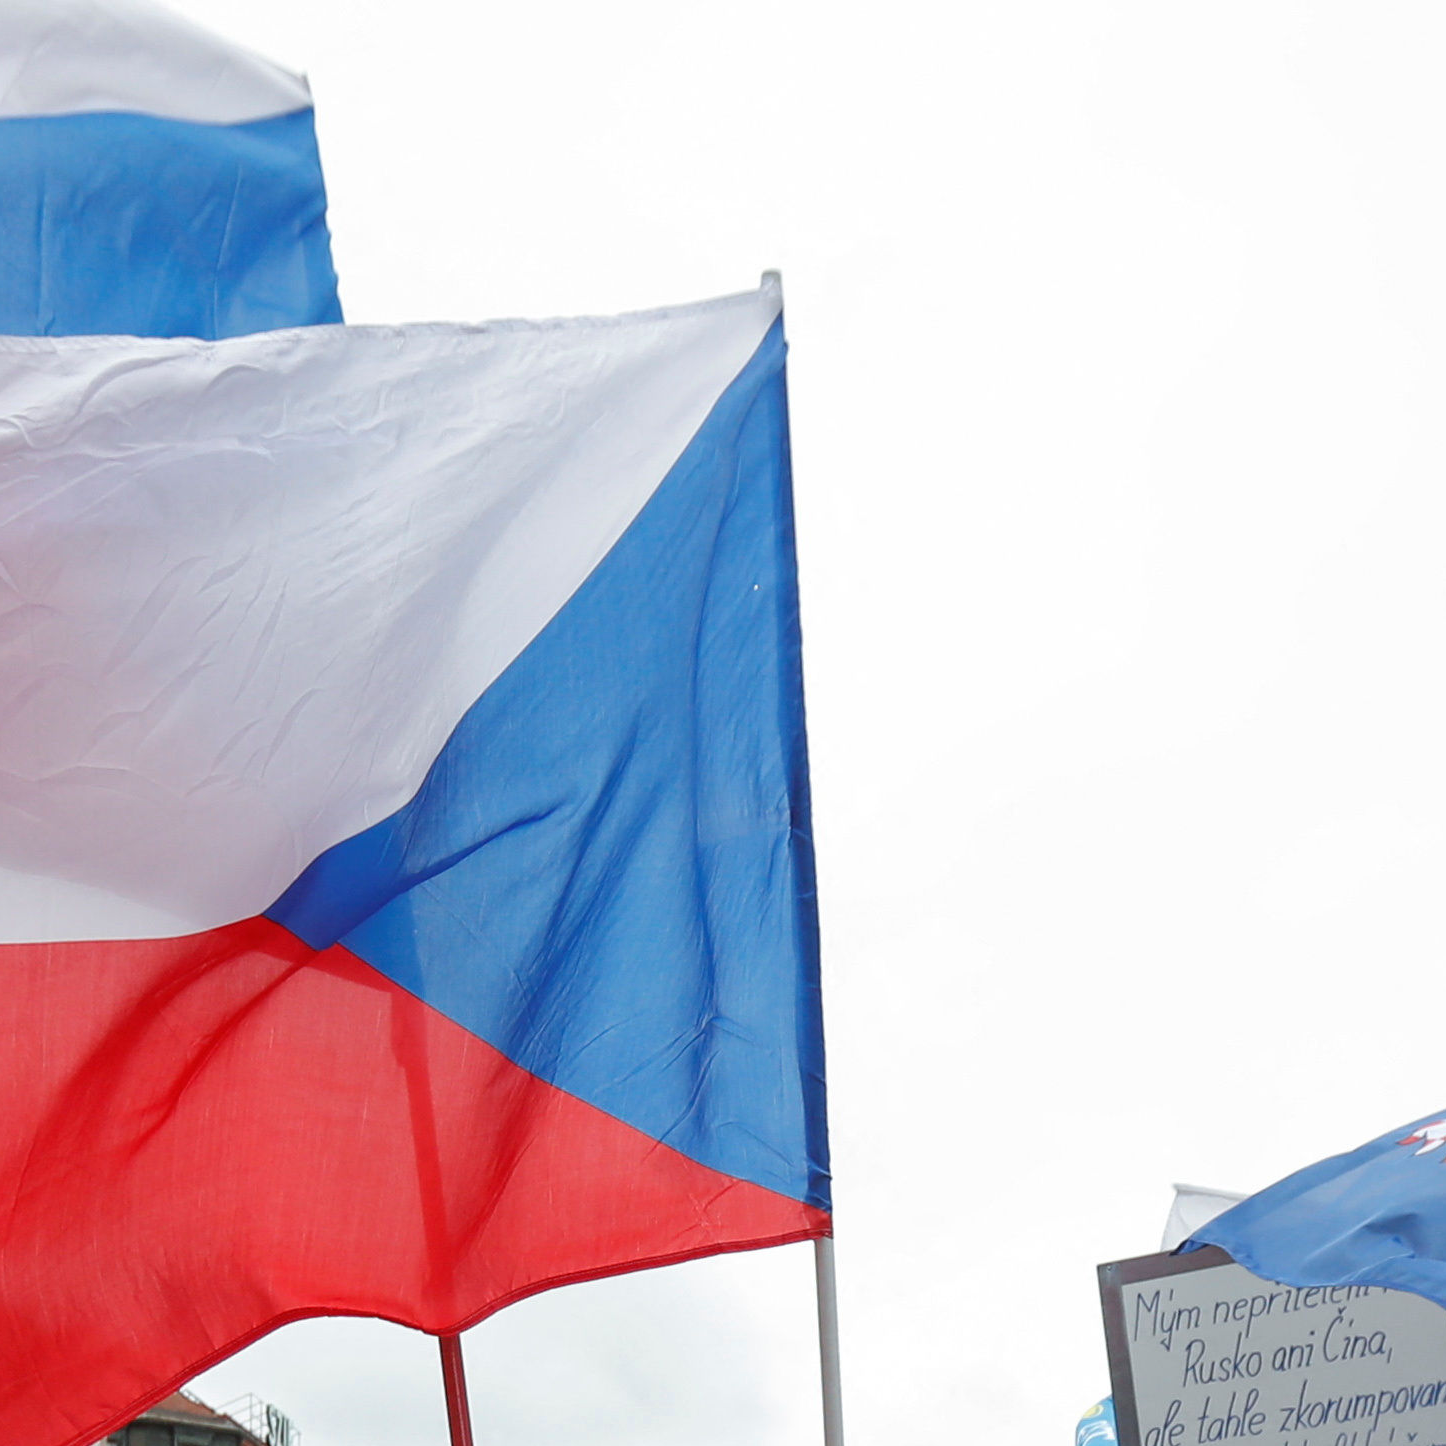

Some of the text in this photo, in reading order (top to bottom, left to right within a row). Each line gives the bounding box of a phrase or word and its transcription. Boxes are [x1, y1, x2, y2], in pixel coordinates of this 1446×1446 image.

[1133, 1288, 1201, 1352] Mým
[1181, 1305, 1394, 1388] Rusko ani Čína,
[1196, 1387, 1267, 1446] tahle
